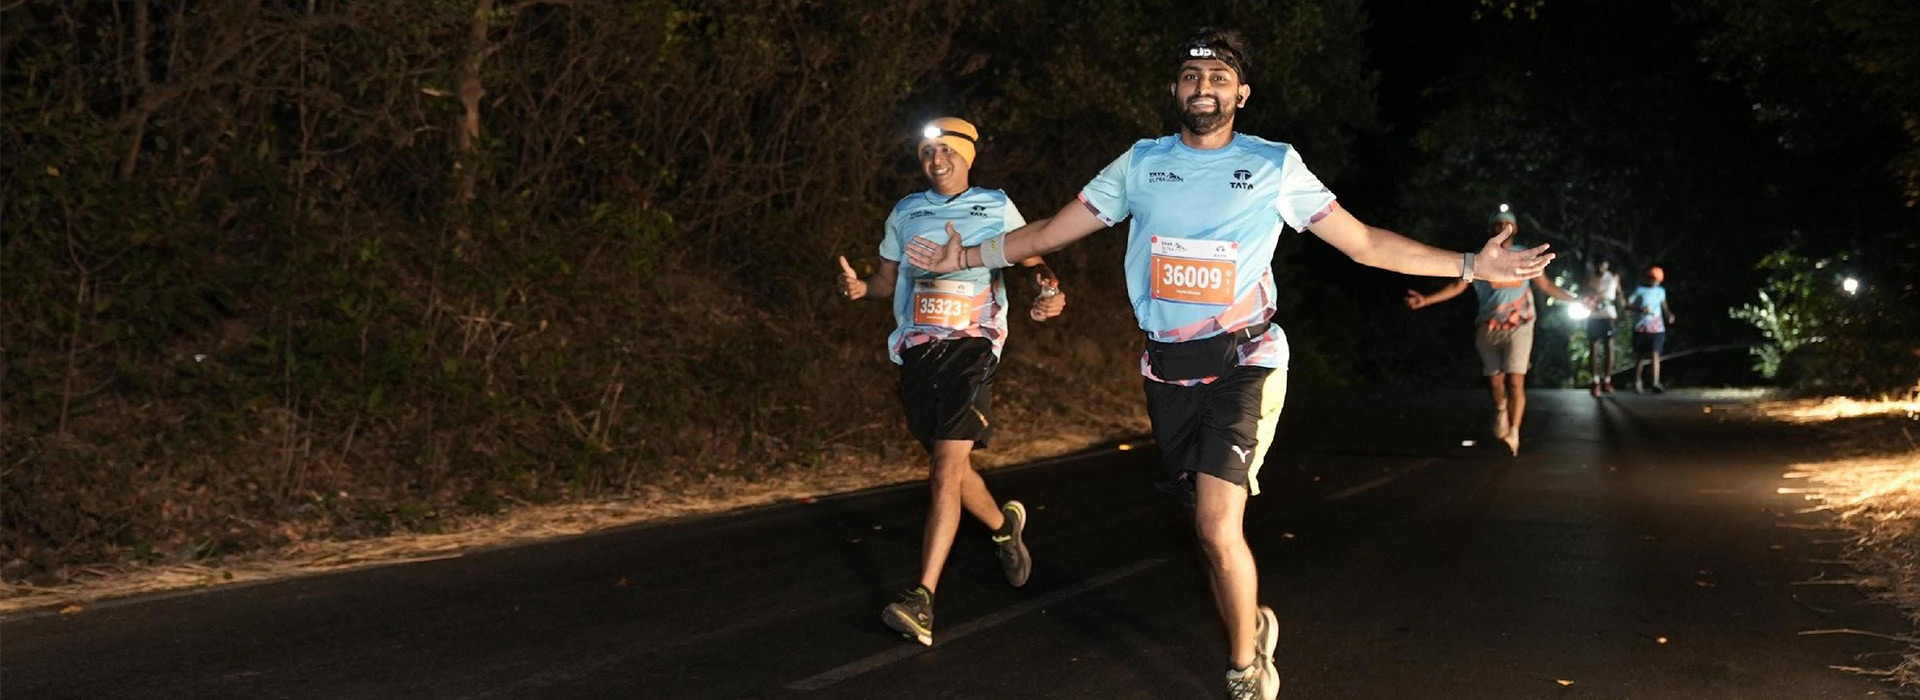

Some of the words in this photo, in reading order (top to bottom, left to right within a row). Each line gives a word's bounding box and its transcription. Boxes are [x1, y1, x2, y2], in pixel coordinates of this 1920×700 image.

[1229, 181, 1254, 190] TATA
[1162, 263, 1222, 290] 36009
[920, 298, 962, 317] 35323
